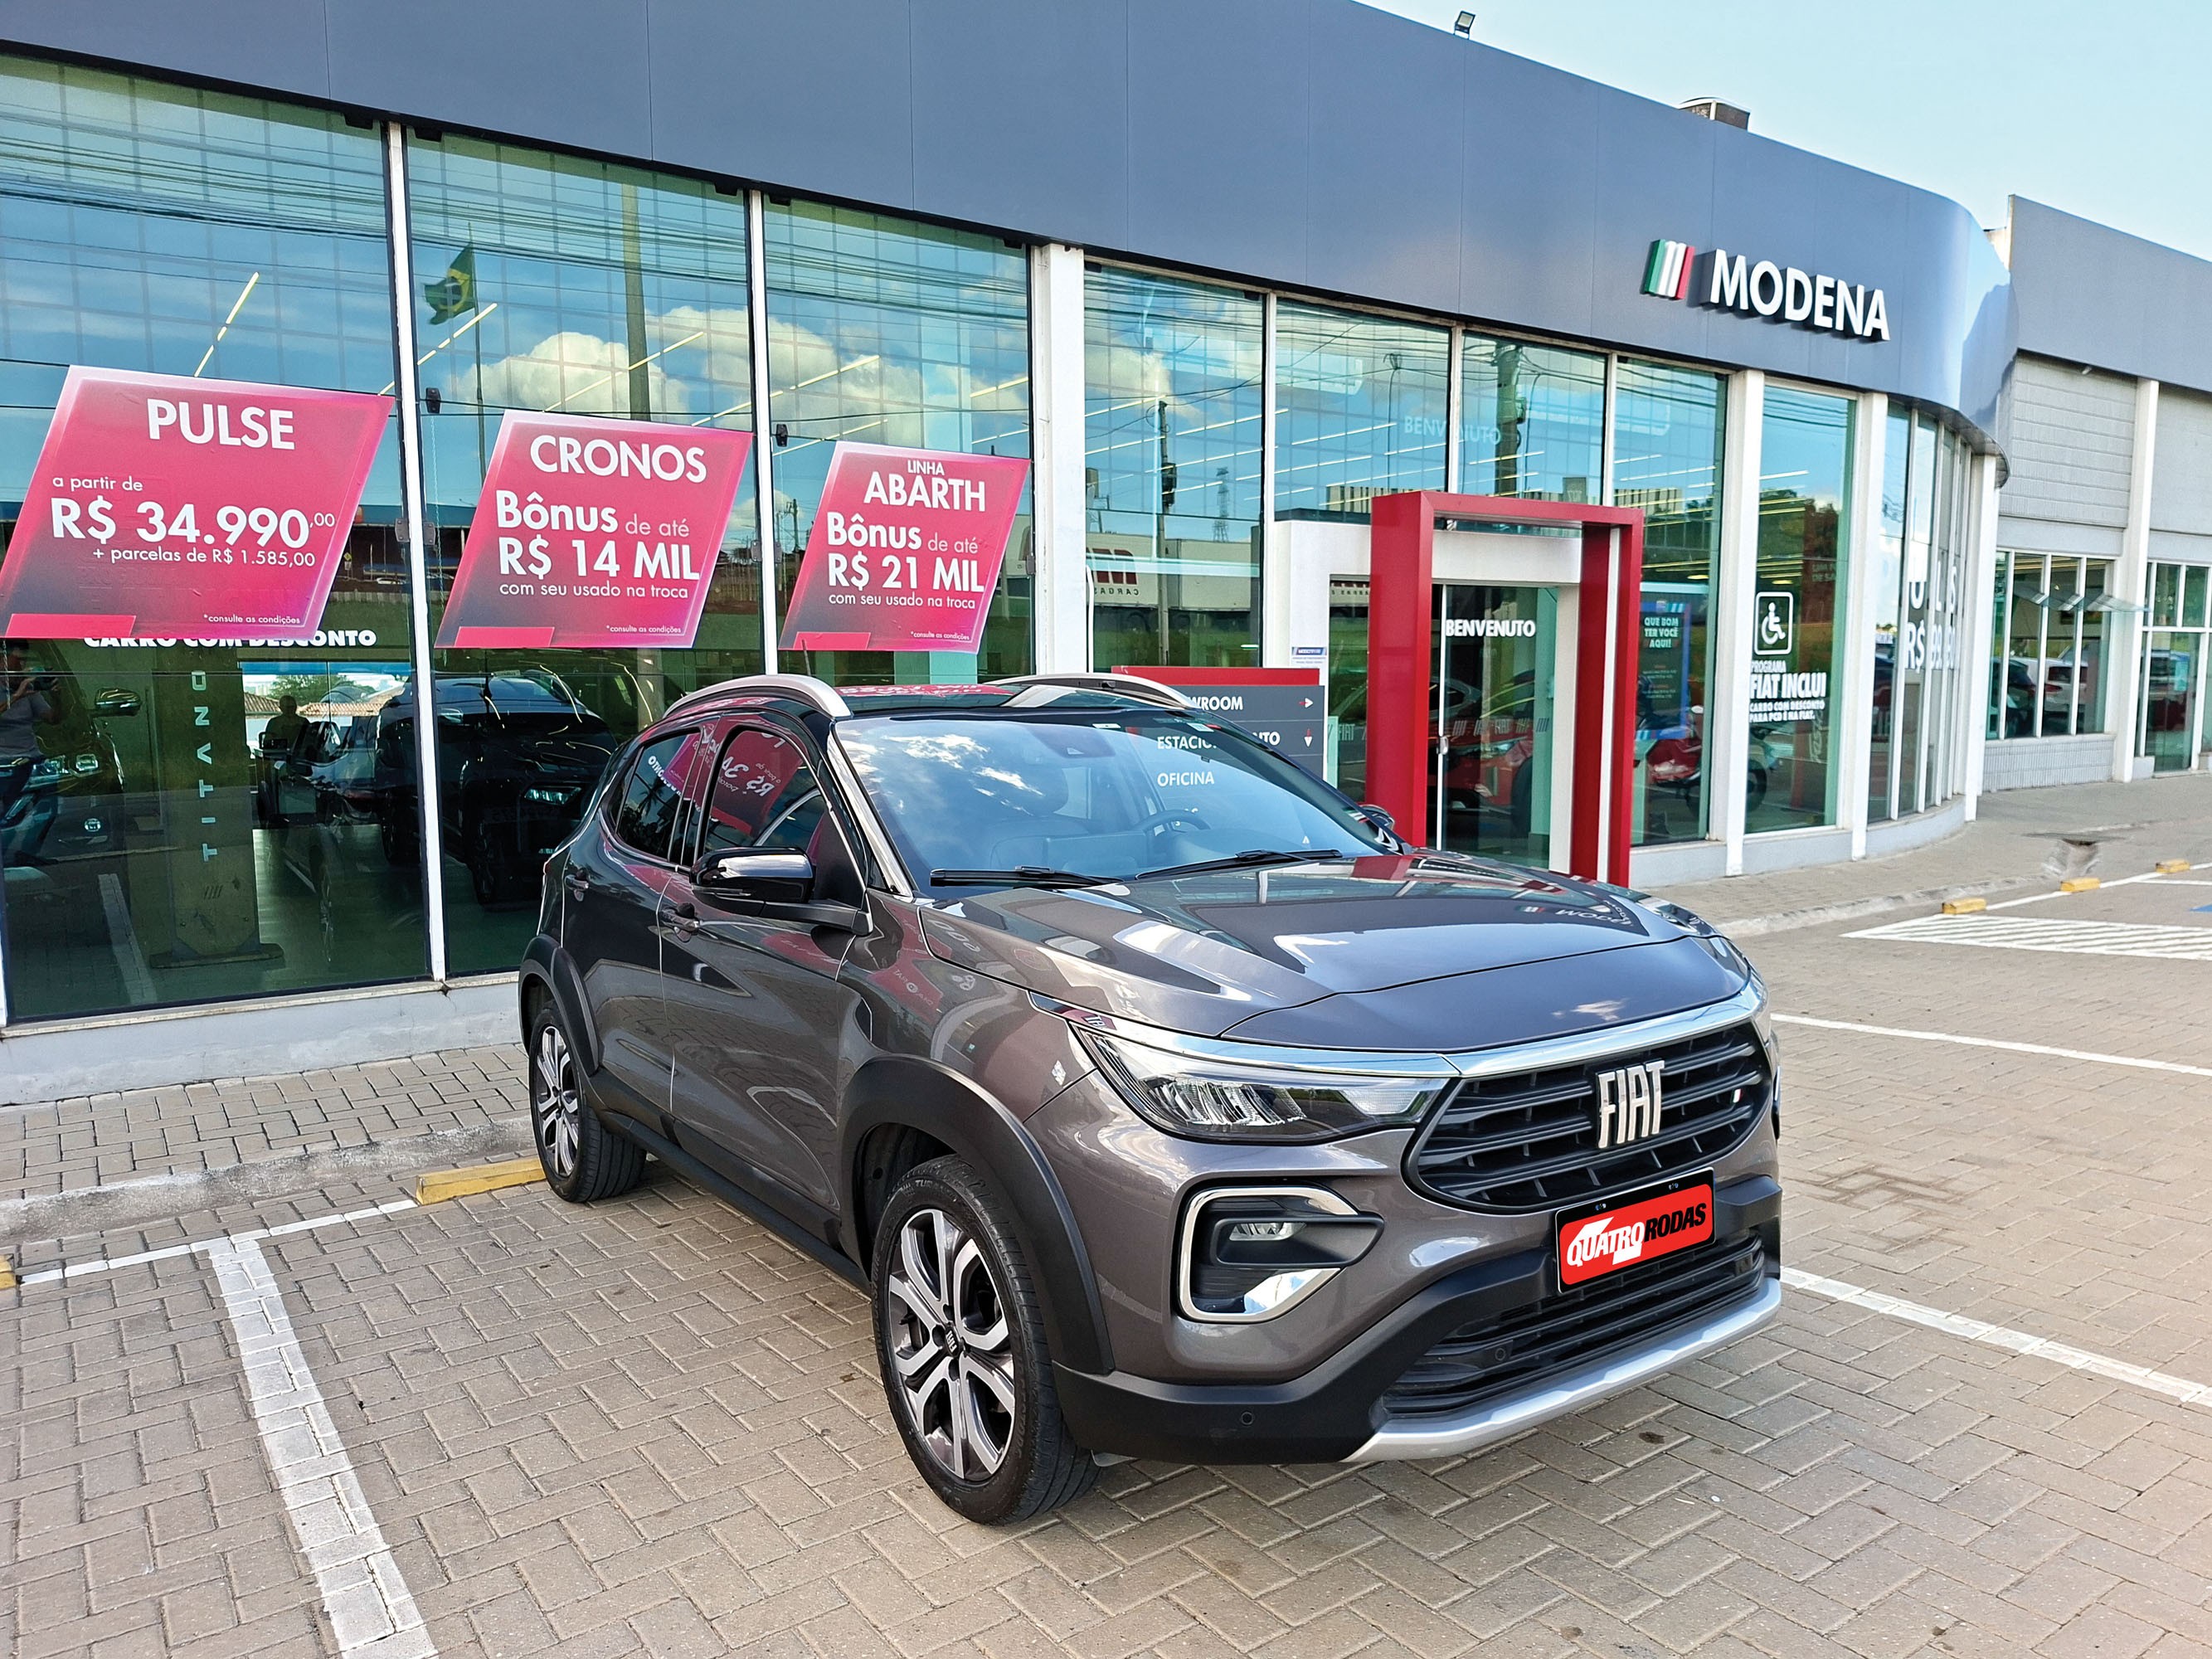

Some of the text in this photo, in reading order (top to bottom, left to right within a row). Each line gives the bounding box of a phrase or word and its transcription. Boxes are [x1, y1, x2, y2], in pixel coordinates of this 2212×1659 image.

[1709, 248, 1890, 341] MODENA
[147, 398, 295, 450] PULSE
[1404, 416, 1501, 445] BENVNUTO
[530, 435, 707, 483] CRONOS
[907, 460, 945, 475] LINHA
[52, 475, 143, 492] a partir de
[863, 472, 985, 512] ABARTH
[51, 495, 116, 545] R$
[496, 489, 689, 538] Bônus de até
[827, 512, 978, 554] Bônus de até
[111, 547, 181, 564] parcelas
[188, 547, 207, 562] de
[212, 548, 233, 565] R$
[241, 549, 315, 568] 1.585,00
[498, 535, 700, 581] R$ 14 MIL
[829, 551, 984, 593] R$ 21 MIL
[500, 581, 688, 599] com seu usado na troca
[829, 592, 975, 610] com seu usado na troca
[246, 615, 255, 624] as
[258, 615, 300, 625] condições
[649, 625, 681, 634] condições
[1445, 619, 1536, 638] BENVENUTO
[1645, 617, 1679, 627] QUE BOM
[1645, 626, 1679, 638] TER VOCÊ
[1649, 639, 1672, 649] AQUI!
[1751, 660, 1786, 673] PROGRAMA
[1750, 672, 1826, 699] FIAT INCLUI
[1188, 696, 1243, 711] WROOM
[1750, 700, 1825, 713] CARRO COM DESCONTO
[190, 670, 218, 863] TITANO
[1157, 771, 1215, 787] OFICINA
[1597, 1060, 1665, 1149] FIAT
